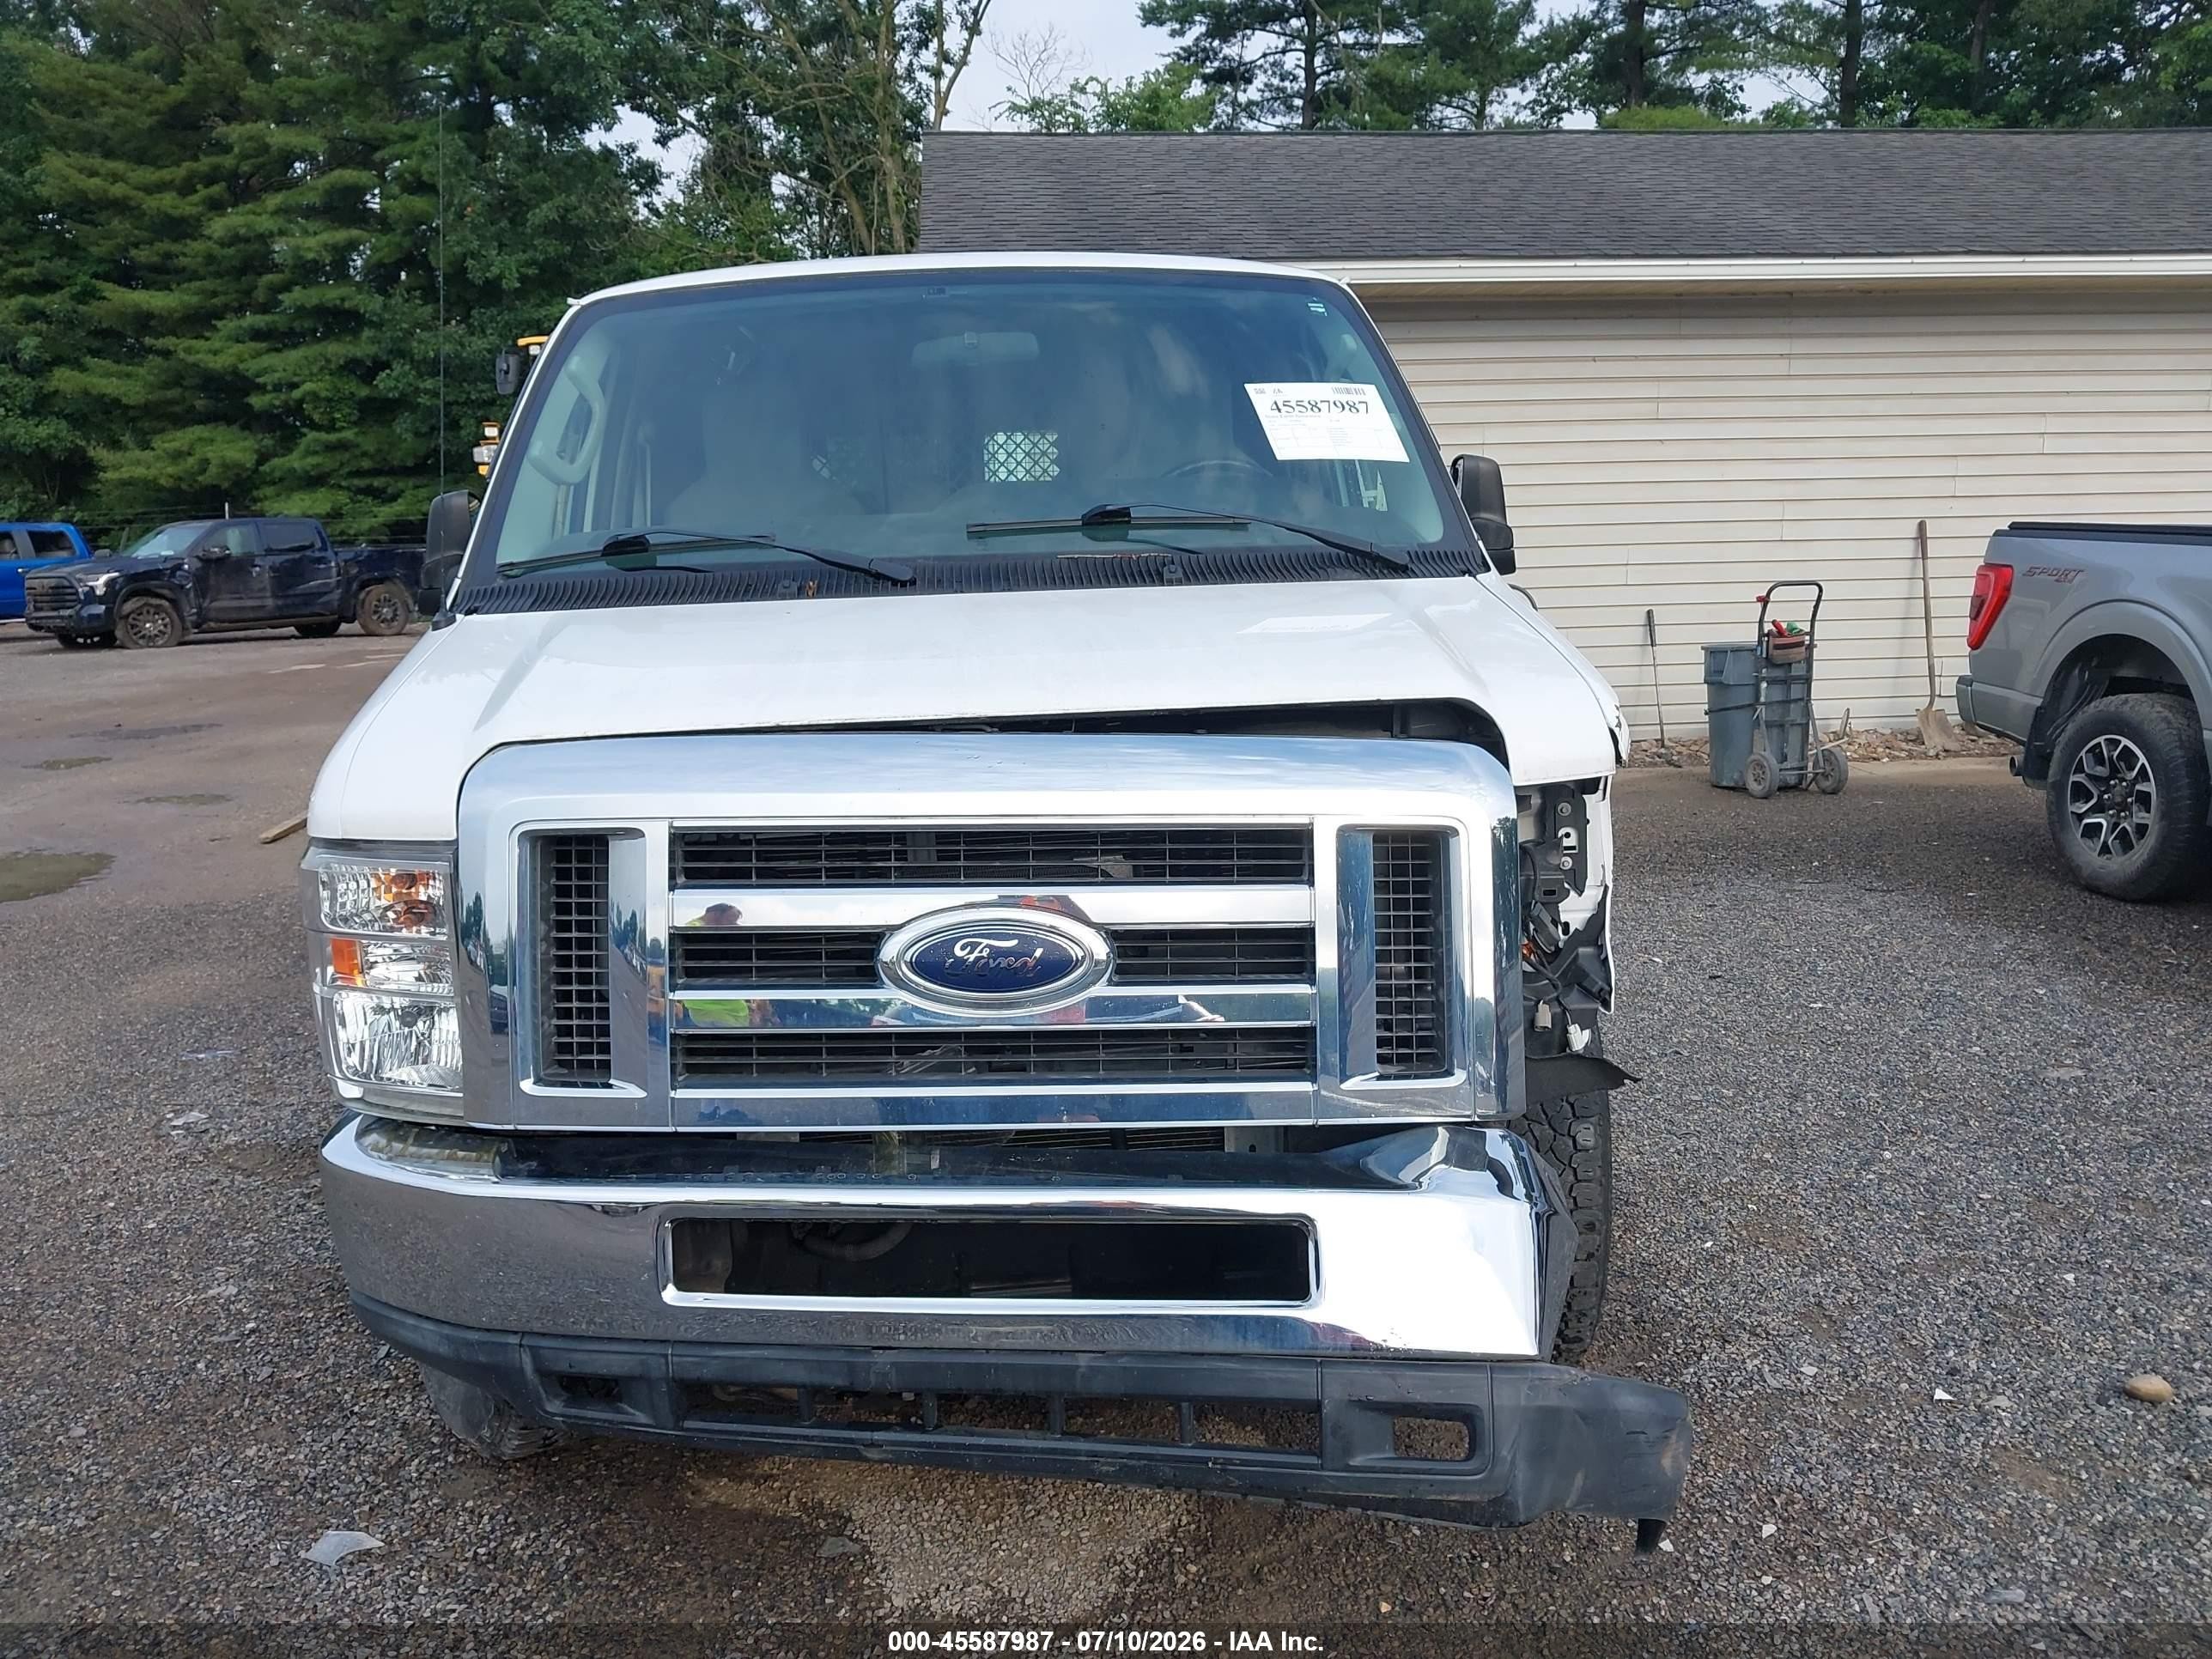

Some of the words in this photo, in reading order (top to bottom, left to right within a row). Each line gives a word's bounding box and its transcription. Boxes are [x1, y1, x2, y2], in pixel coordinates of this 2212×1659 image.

[1270, 399, 1369, 415] 45587987
[2021, 566, 2085, 577] SPORT
[944, 937, 1044, 978] Ford
